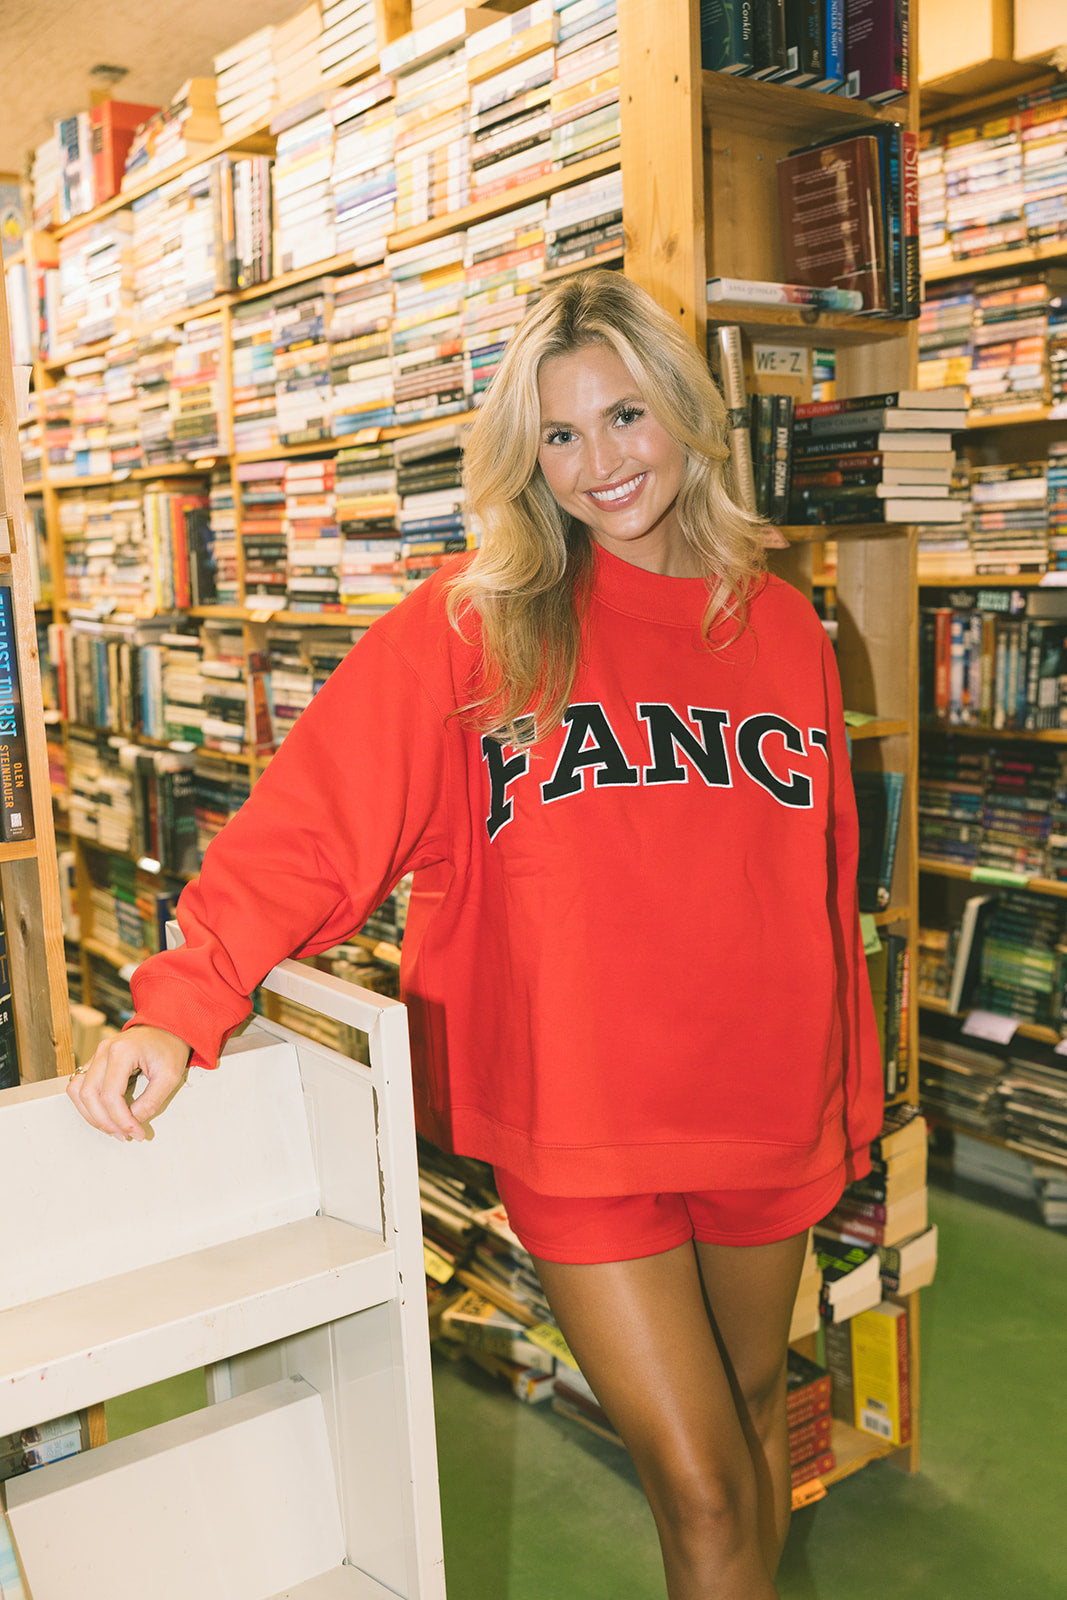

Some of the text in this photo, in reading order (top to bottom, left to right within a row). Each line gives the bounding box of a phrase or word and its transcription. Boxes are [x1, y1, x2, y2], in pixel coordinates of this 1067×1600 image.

[741, 2, 751, 41] Conklin
[0, 676, 17, 737] TOURIST
[0, 744, 15, 808] STEINHAUER
[13, 761, 25, 788] OLEN
